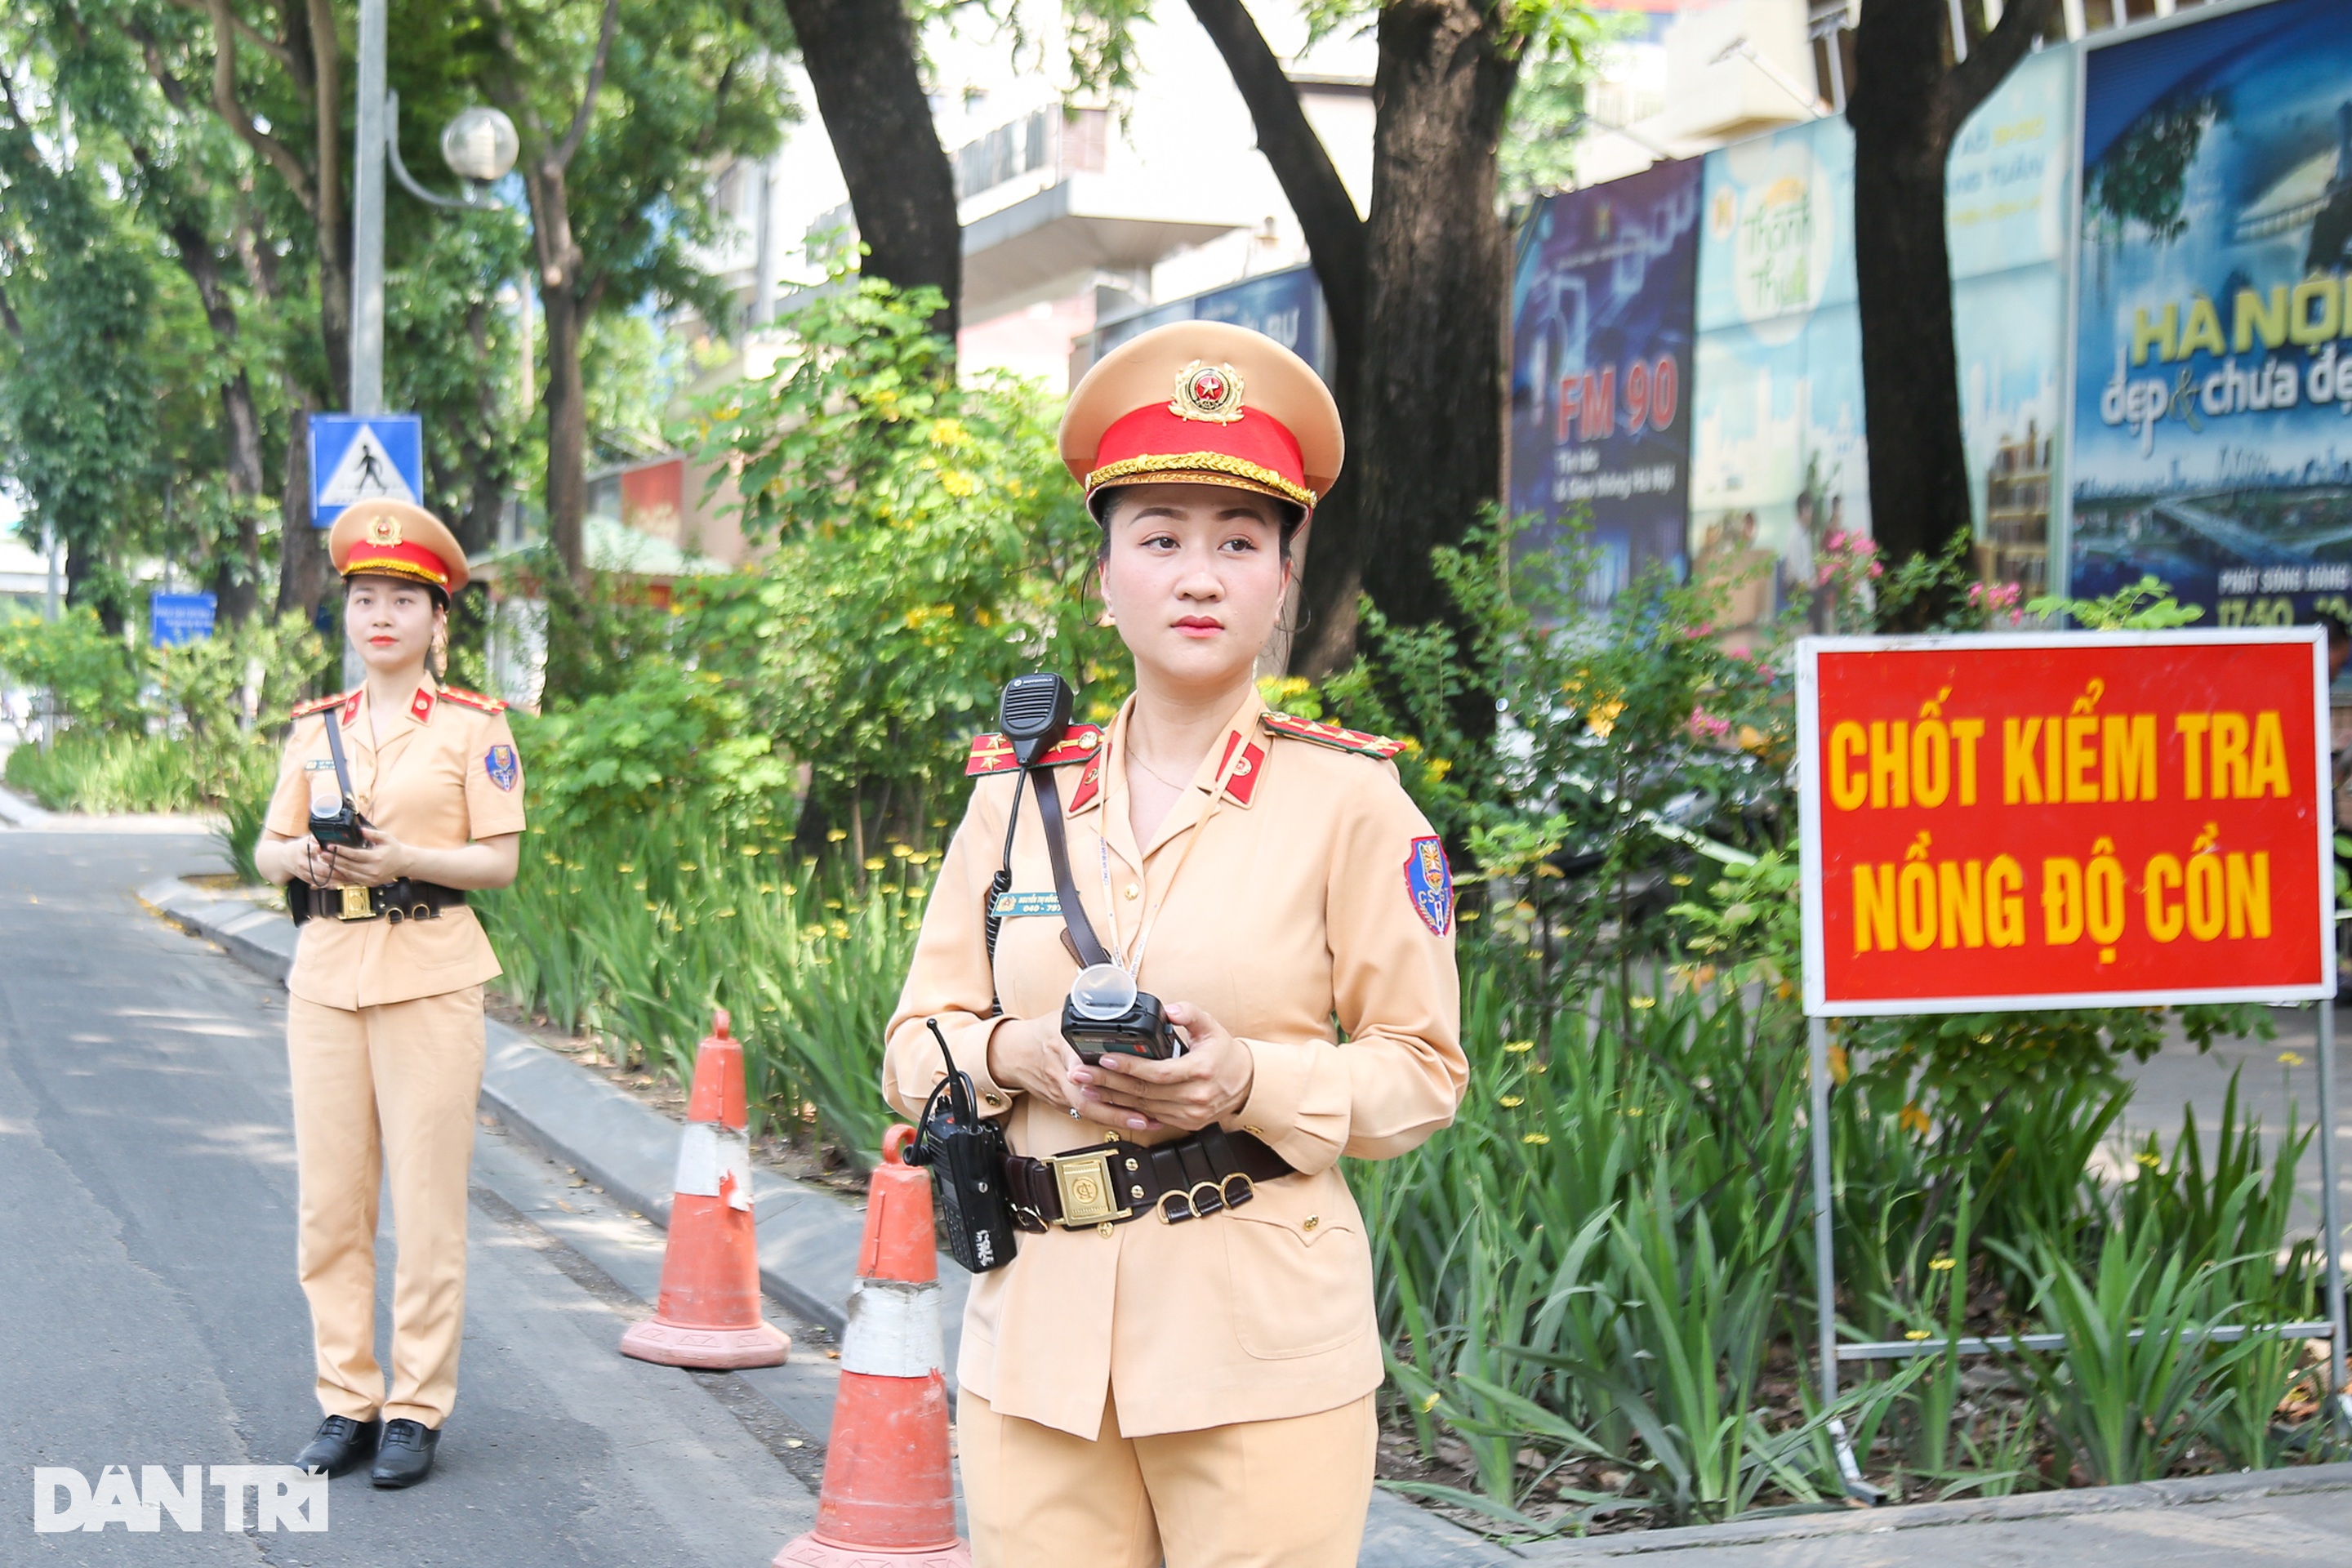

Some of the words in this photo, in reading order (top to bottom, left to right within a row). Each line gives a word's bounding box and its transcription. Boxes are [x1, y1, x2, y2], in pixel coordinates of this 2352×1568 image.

[1555, 367, 1617, 445] FM
[1623, 355, 1679, 436] 90
[2100, 344, 2169, 458] đẹp
[2200, 357, 2299, 417] chưa
[2217, 565, 2258, 596] PHÁT
[2258, 564, 2304, 595] SÓNG
[1829, 684, 1985, 811] CHỐT
[2002, 676, 2158, 806] KIỂM
[2175, 710, 2292, 800] TRA
[1851, 829, 2026, 959] NỒNG
[2041, 835, 2127, 965] ĐỘ
[2141, 820, 2273, 945] CỒN
